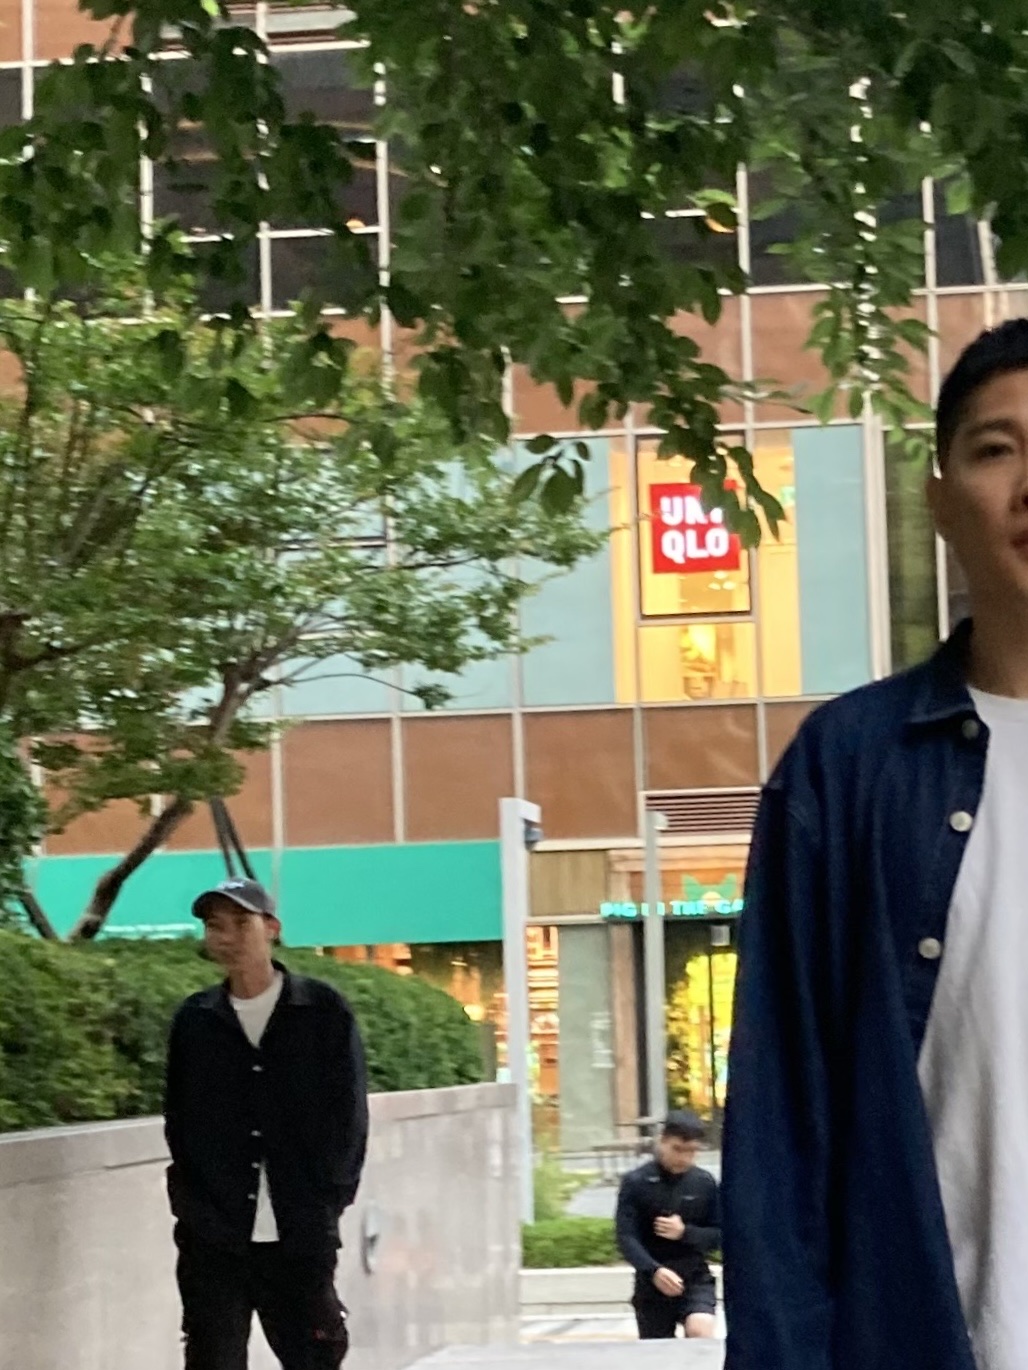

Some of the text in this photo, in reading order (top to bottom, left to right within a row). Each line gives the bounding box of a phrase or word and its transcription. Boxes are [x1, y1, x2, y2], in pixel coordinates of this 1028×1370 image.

[661, 527, 730, 565] QLO
[600, 902, 638, 919] PIG
[669, 900, 709, 917] THE
[714, 899, 745, 914] GA
